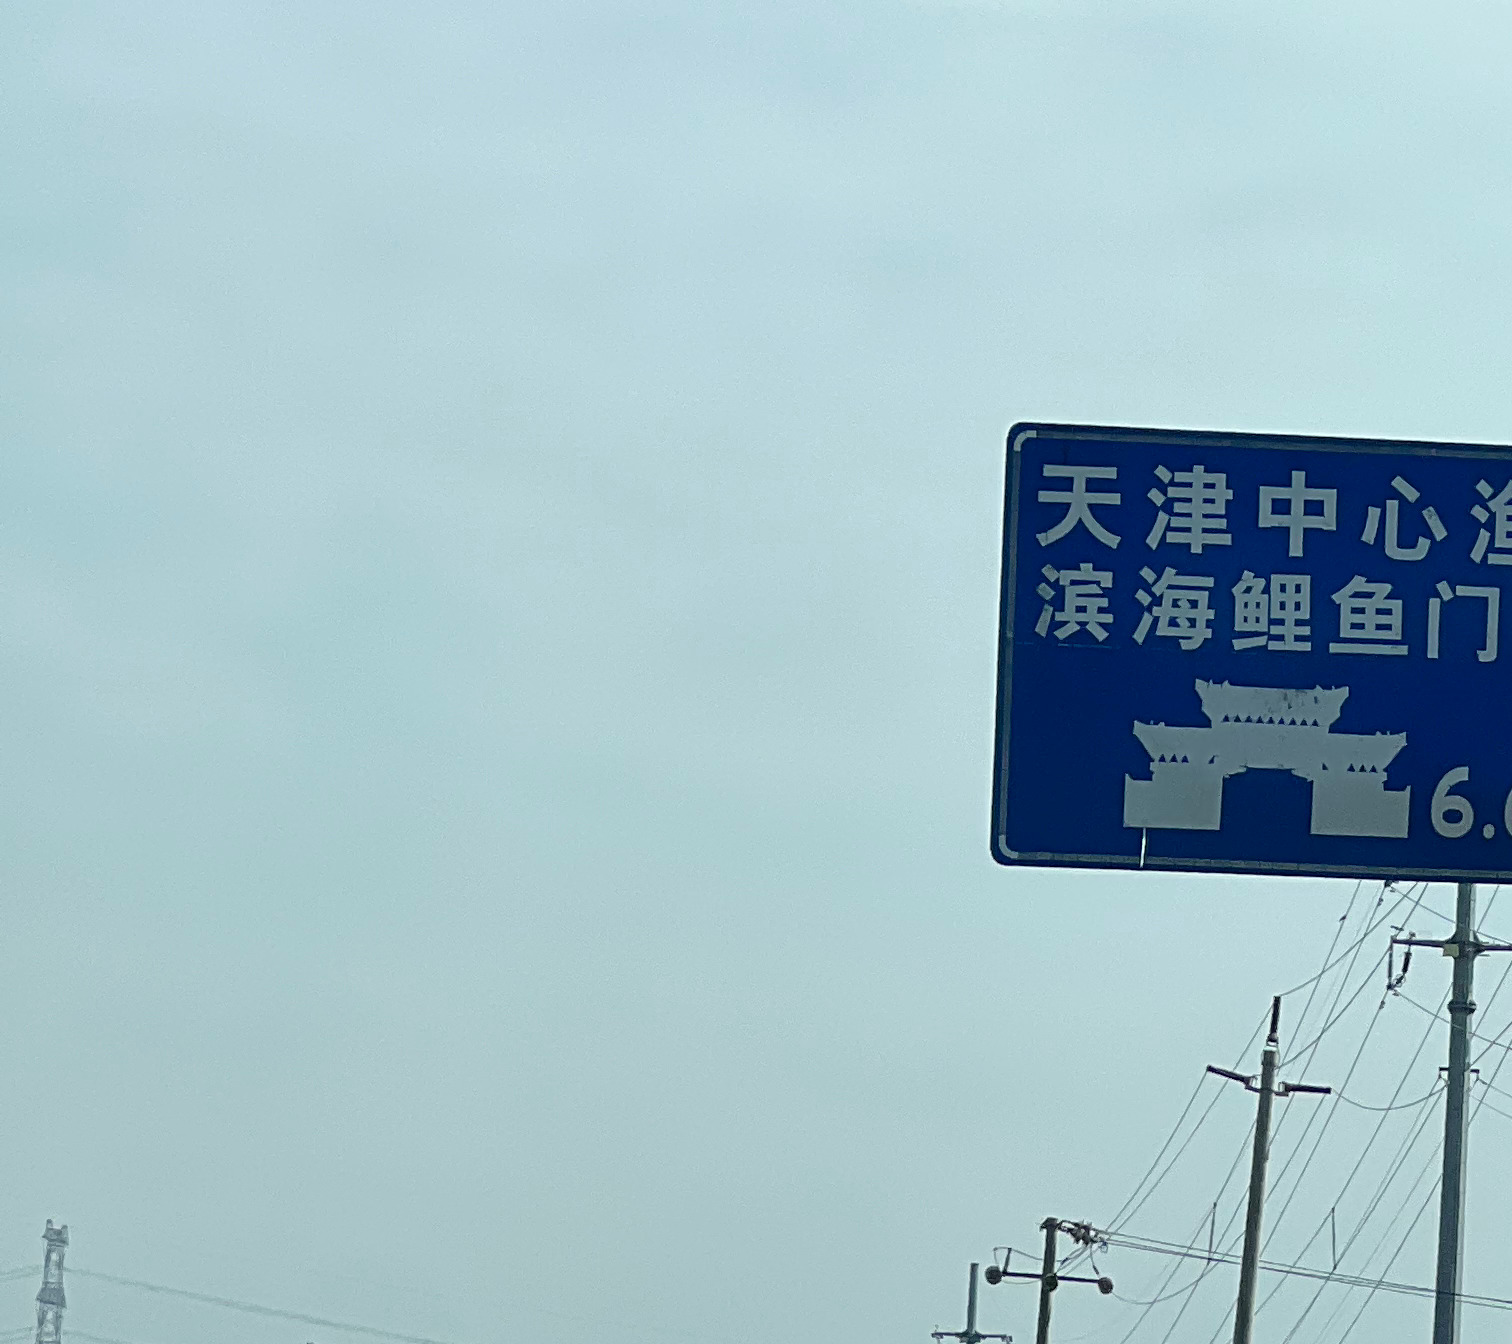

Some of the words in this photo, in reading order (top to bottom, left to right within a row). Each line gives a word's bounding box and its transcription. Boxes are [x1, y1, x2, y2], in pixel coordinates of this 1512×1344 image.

[1033, 562, 1501, 663] 滨海鲤鱼门
